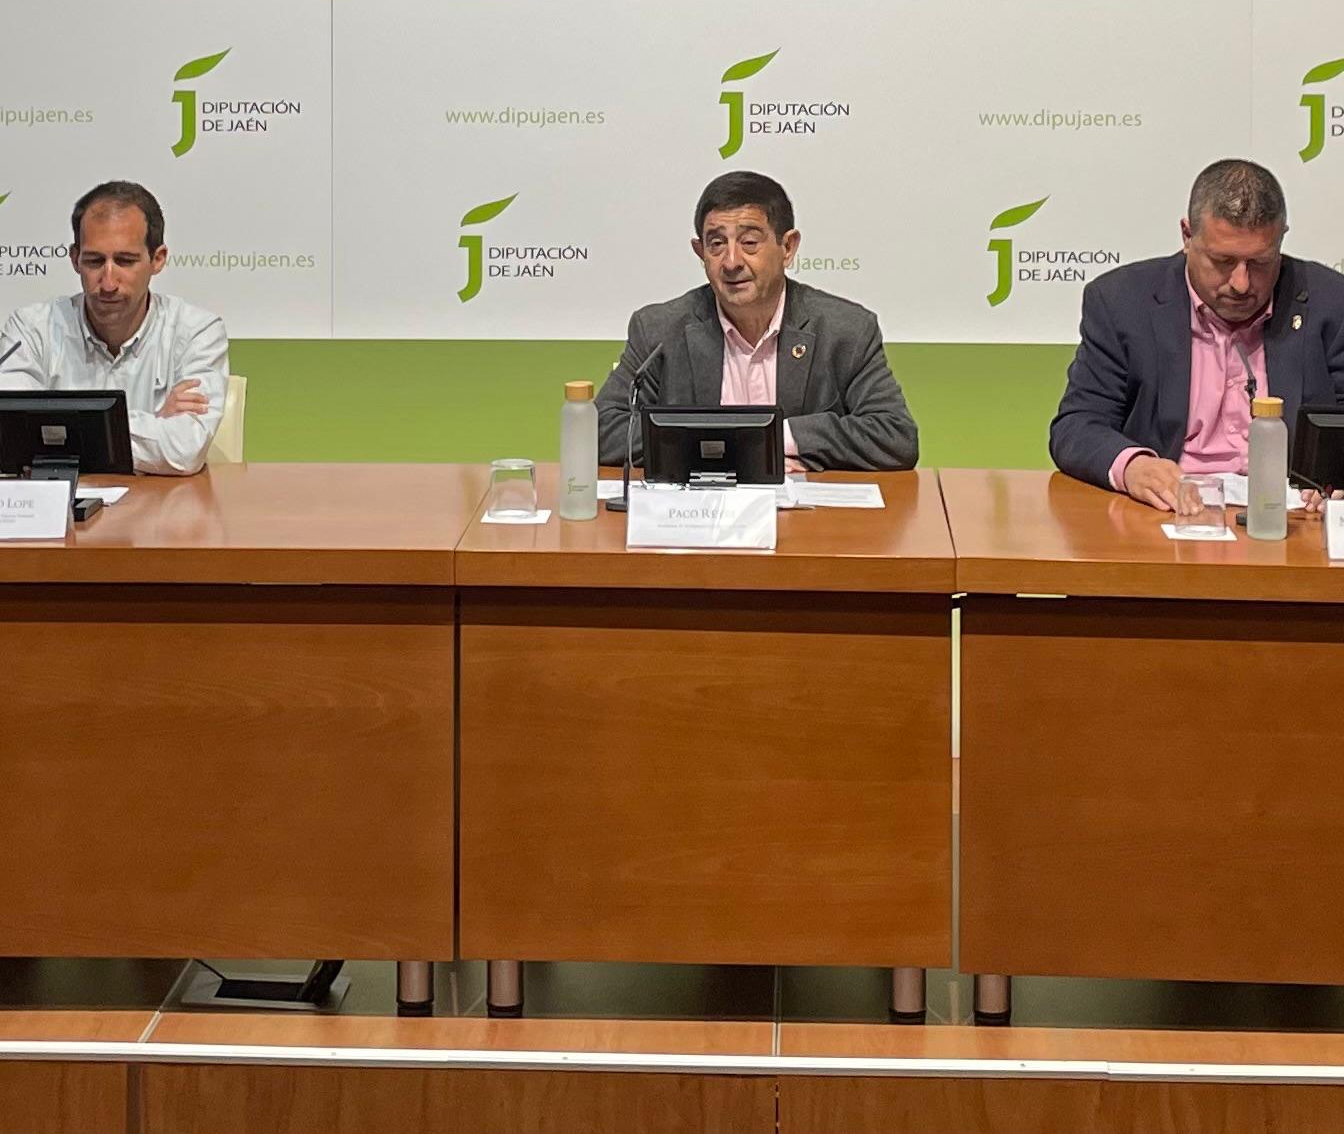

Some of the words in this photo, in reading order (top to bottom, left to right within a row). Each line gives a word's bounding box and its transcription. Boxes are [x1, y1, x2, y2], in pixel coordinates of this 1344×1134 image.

[203, 100, 300, 114] DIPUTACIÓN
[750, 101, 849, 116] DIPUTACIÓN
[203, 120, 223, 131] DE
[227, 117, 269, 131] JAÉN
[445, 107, 604, 128] www.dipujaen.es
[979, 109, 1141, 130] www.dipujaen.es
[750, 122, 771, 133] DE
[775, 119, 815, 133] JAÉN
[489, 245, 587, 259] DIPUTACIÓN
[1019, 250, 1119, 264] DIPUTACIÓN
[7, 262, 46, 275] JAÉN
[489, 265, 510, 277] DE
[514, 262, 554, 277] JAÉN
[1019, 269, 1040, 281] DE
[1044, 266, 1085, 281] JAÉN
[7, 497, 34, 509] LOPE
[669, 508, 699, 519] PACO
